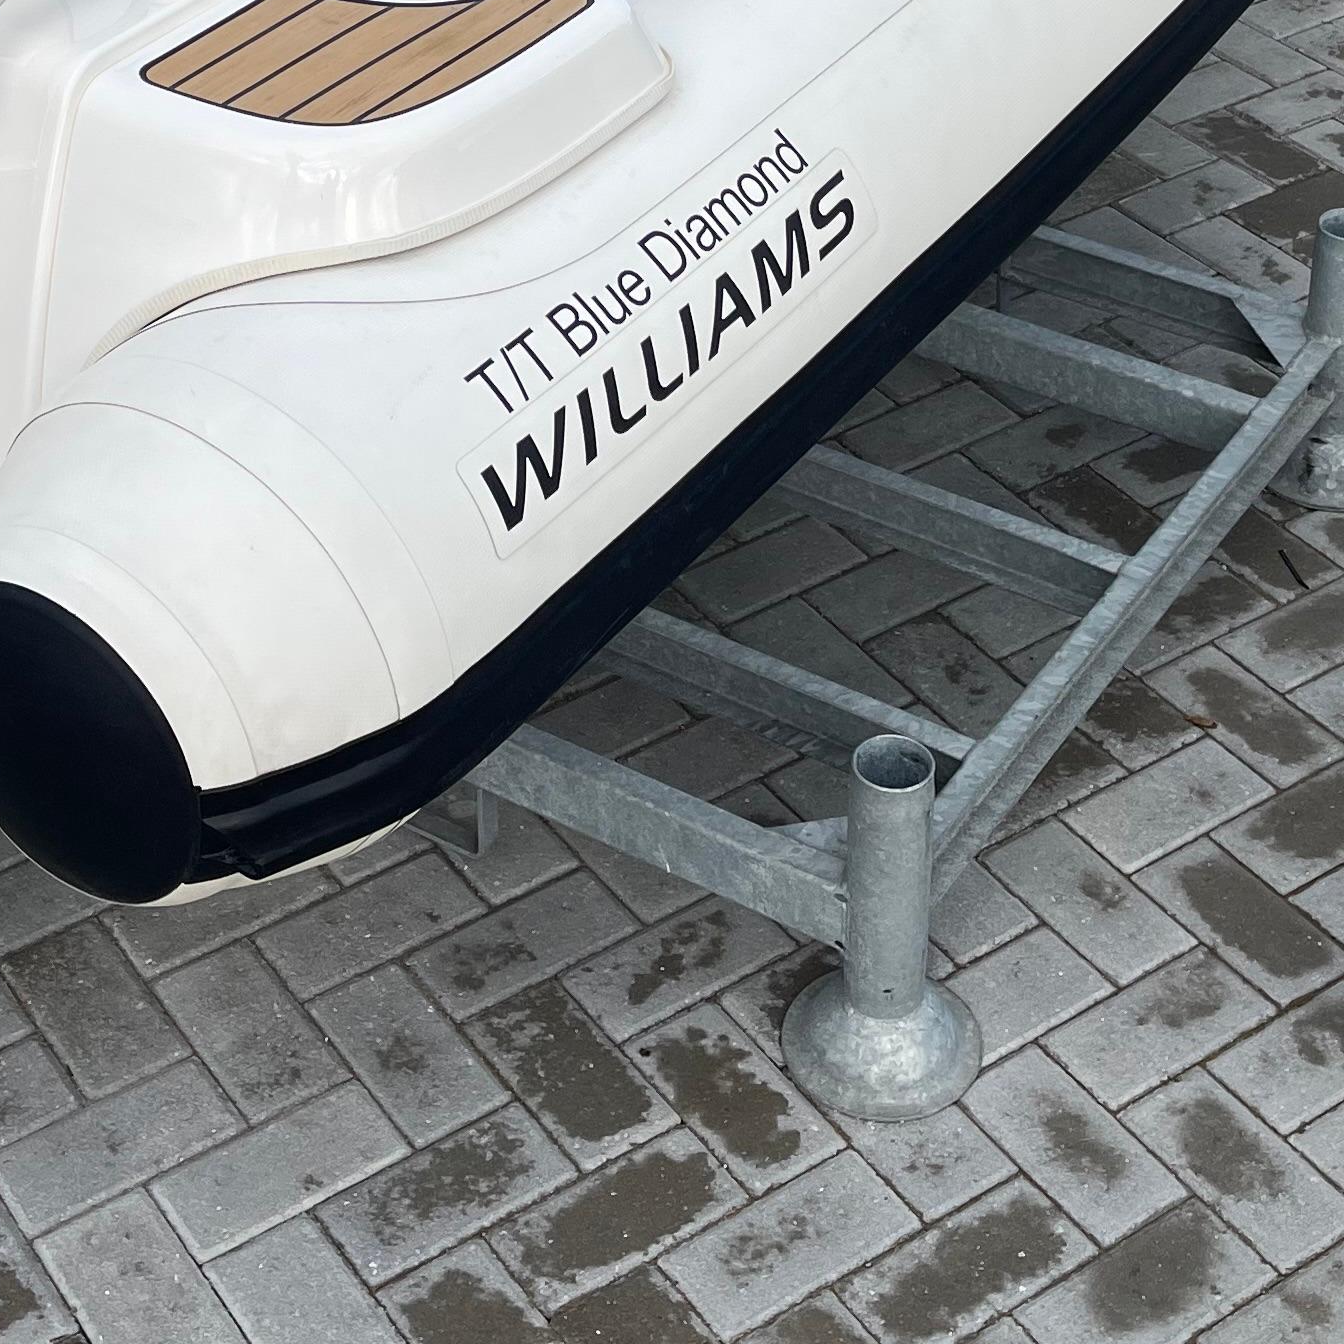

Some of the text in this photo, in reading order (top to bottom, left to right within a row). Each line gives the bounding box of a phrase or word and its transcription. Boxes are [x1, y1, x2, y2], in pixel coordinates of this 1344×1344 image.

[463, 127, 810, 415] T/T Blue Diamond
[480, 169, 857, 533] WILLIAMS
